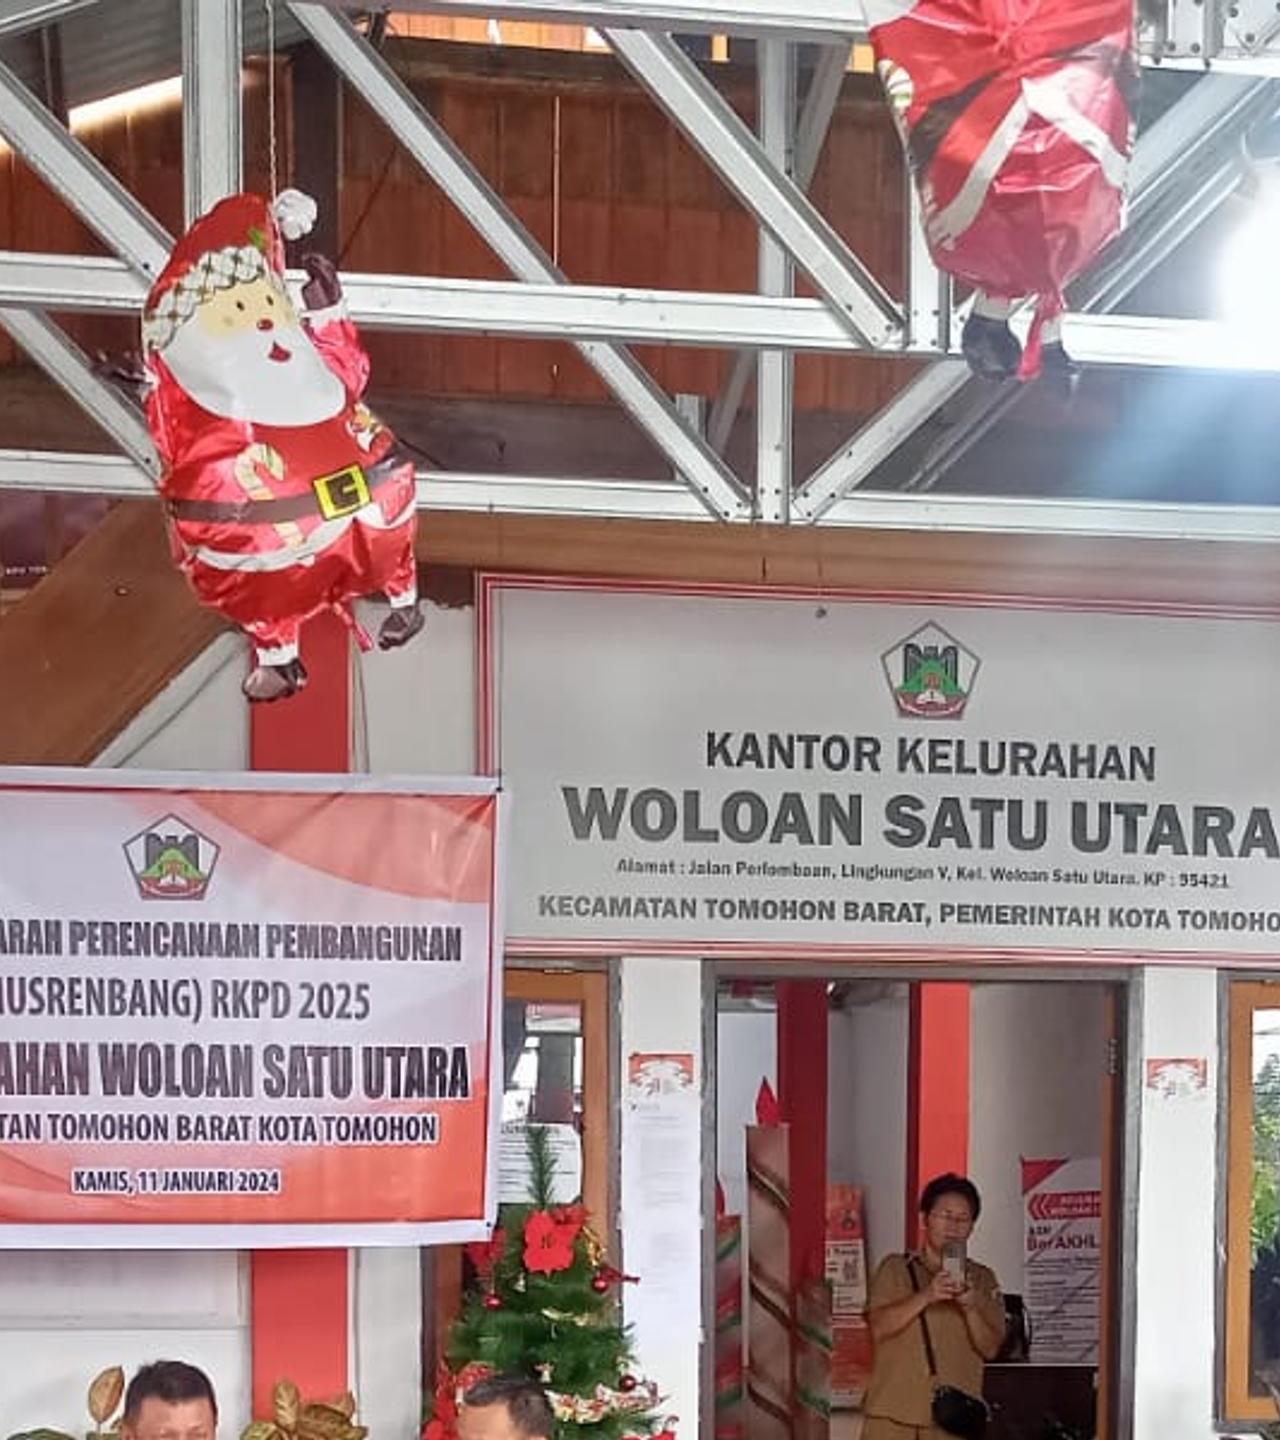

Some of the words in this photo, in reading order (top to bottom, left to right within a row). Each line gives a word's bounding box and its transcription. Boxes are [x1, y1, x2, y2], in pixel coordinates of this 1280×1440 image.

[706, 730, 881, 774] KANTOR
[897, 738, 1157, 782] KELURAHAN
[563, 787, 863, 848] WOLOAN
[884, 793, 1047, 852] SATU
[617, 858, 675, 875] Alamat
[688, 860, 731, 876] Jalan
[841, 864, 934, 882] Lingkungan
[990, 867, 1049, 883] Woloan
[1053, 868, 1088, 884] Satu
[1144, 872, 1166, 887] KP
[539, 895, 697, 920] KECAMATAN
[703, 898, 836, 922] TOMOHON
[843, 901, 932, 927] BARAT,
[940, 903, 1101, 928] PEMERINTAH
[1108, 907, 1171, 930] KOTA
[70, 919, 260, 960] PERENCANAAN
[266, 923, 461, 962] PEMBANGUNAN
[211, 979, 292, 1019] RKPD
[299, 981, 372, 1021] 2025
[98, 1042, 253, 1098] WOLOAN
[263, 1044, 353, 1099] SATU
[362, 1046, 469, 1099] UTARA
[48, 1114, 170, 1142] TOMOHON
[176, 1115, 251, 1143] BARAT
[257, 1115, 319, 1143] KOTA
[324, 1116, 437, 1144] TOMOHON
[73, 1168, 133, 1194] KAMIS,
[139, 1169, 158, 1192] 11
[162, 1168, 235, 1193] JANUARI
[238, 1169, 280, 1193] 2024
[1027, 1235, 1101, 1251] BerAKHL
